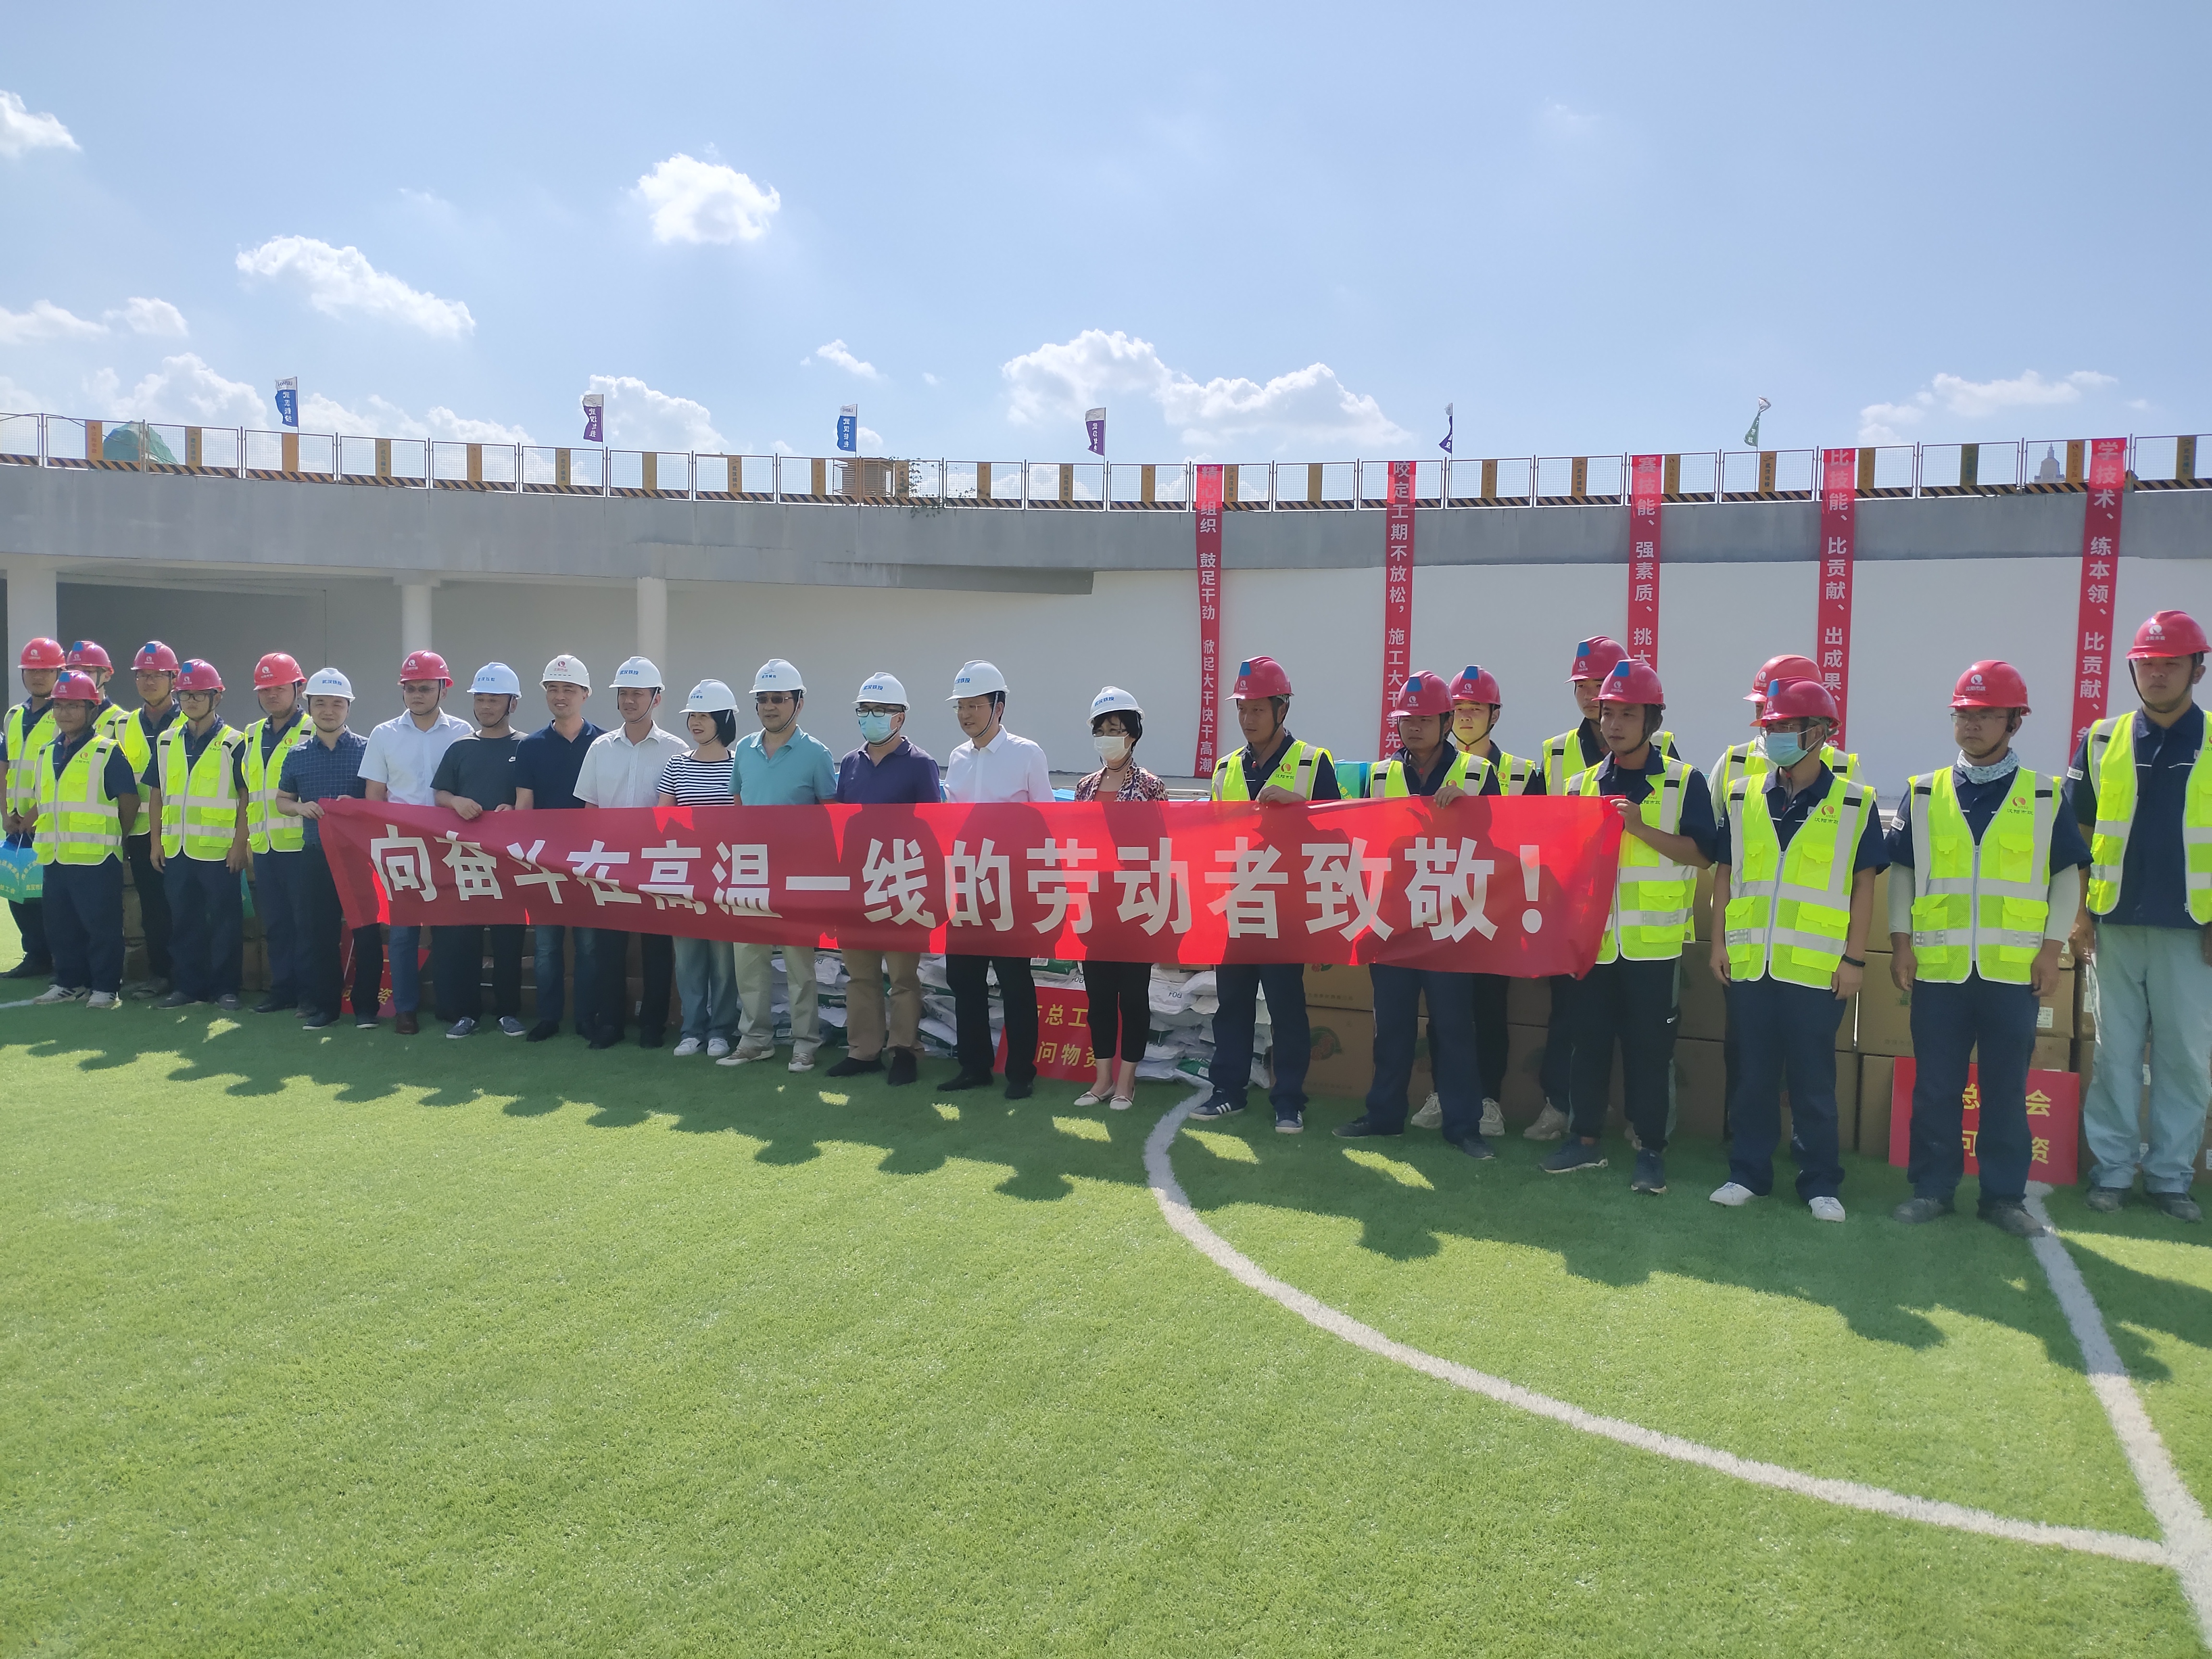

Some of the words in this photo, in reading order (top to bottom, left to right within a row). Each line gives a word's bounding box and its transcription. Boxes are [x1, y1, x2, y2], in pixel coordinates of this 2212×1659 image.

[1200, 553, 1215, 620] 鼓足干劲
[1823, 449, 1850, 749] 比技能、比贡献、出成果、
[1814, 817, 1839, 825] 汉阳市政
[370, 824, 1542, 942] 向奋斗在高温一线的劳动者致敬！
